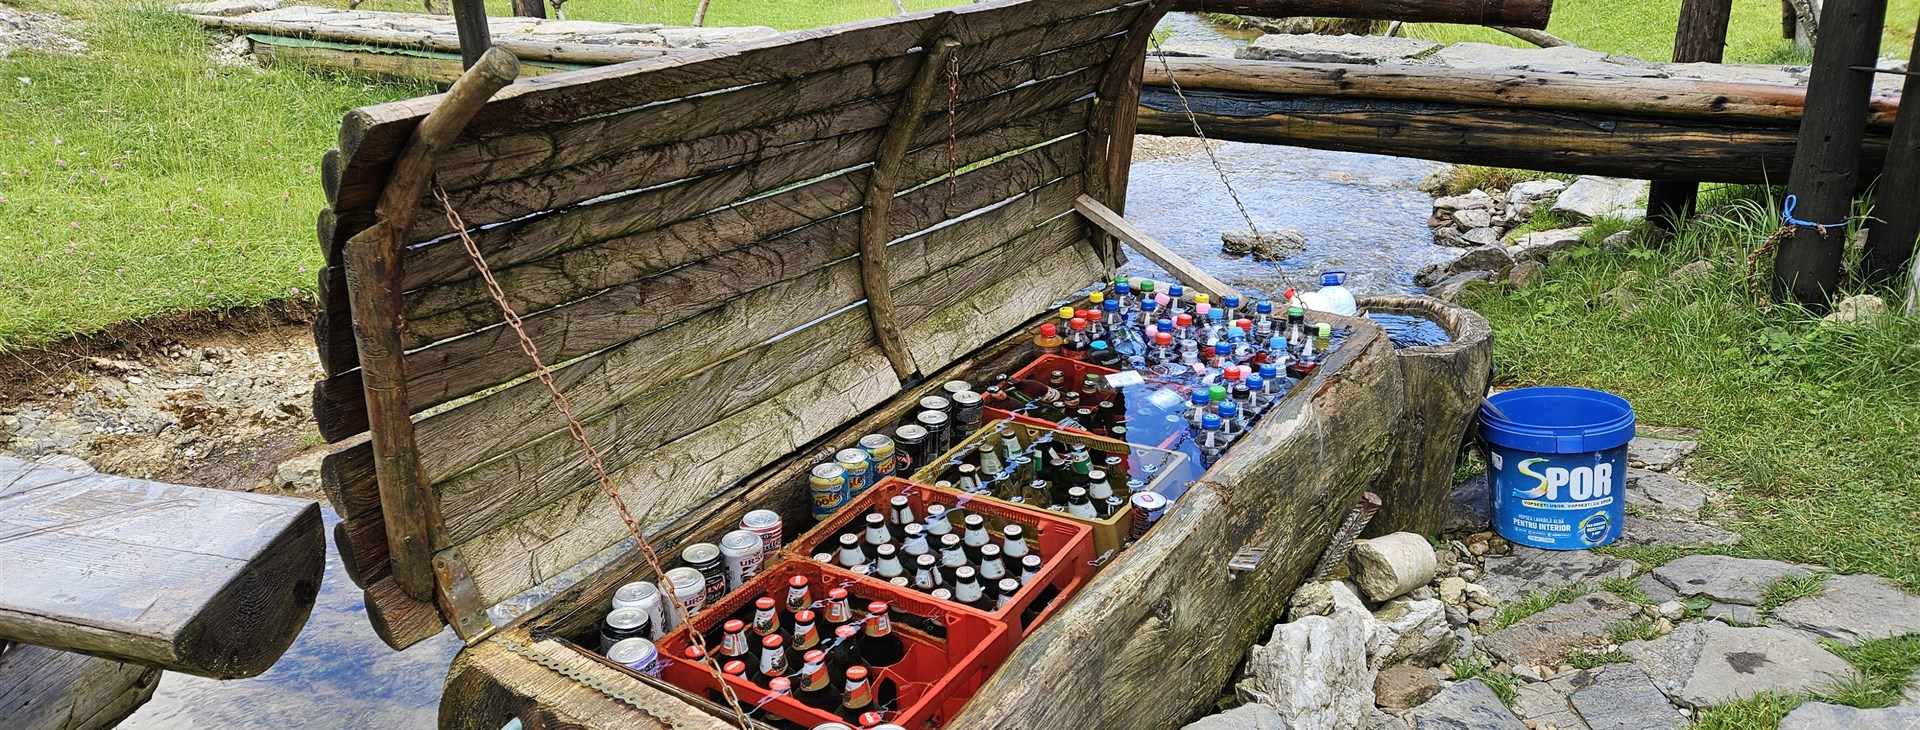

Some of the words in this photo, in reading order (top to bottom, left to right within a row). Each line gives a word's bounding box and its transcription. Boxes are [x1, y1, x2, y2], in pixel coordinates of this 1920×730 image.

[1512, 458, 1613, 501] SPOR
[1513, 517, 1538, 529] PENTRU
[1538, 523, 1571, 532] INTERIOR
[740, 553, 763, 567] URS
